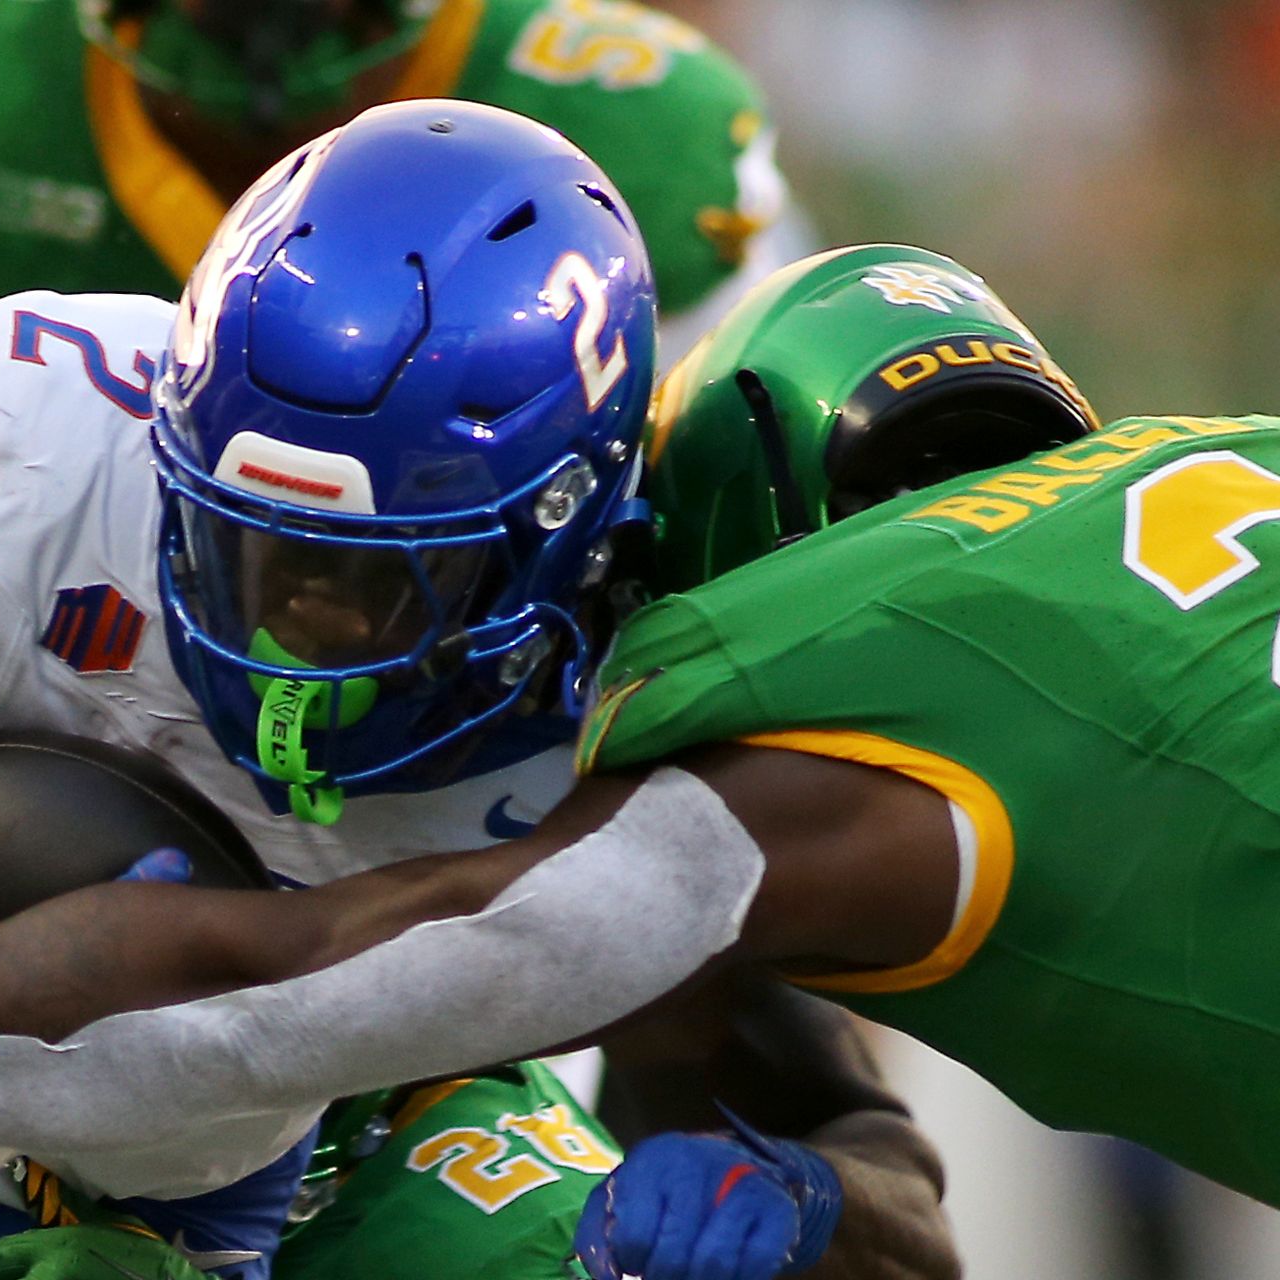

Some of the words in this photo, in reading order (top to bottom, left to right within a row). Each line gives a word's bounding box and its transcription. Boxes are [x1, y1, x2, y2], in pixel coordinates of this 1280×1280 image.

[10, 309, 156, 420] 2
[542, 250, 630, 415] 2
[406, 1103, 625, 1215] 28
